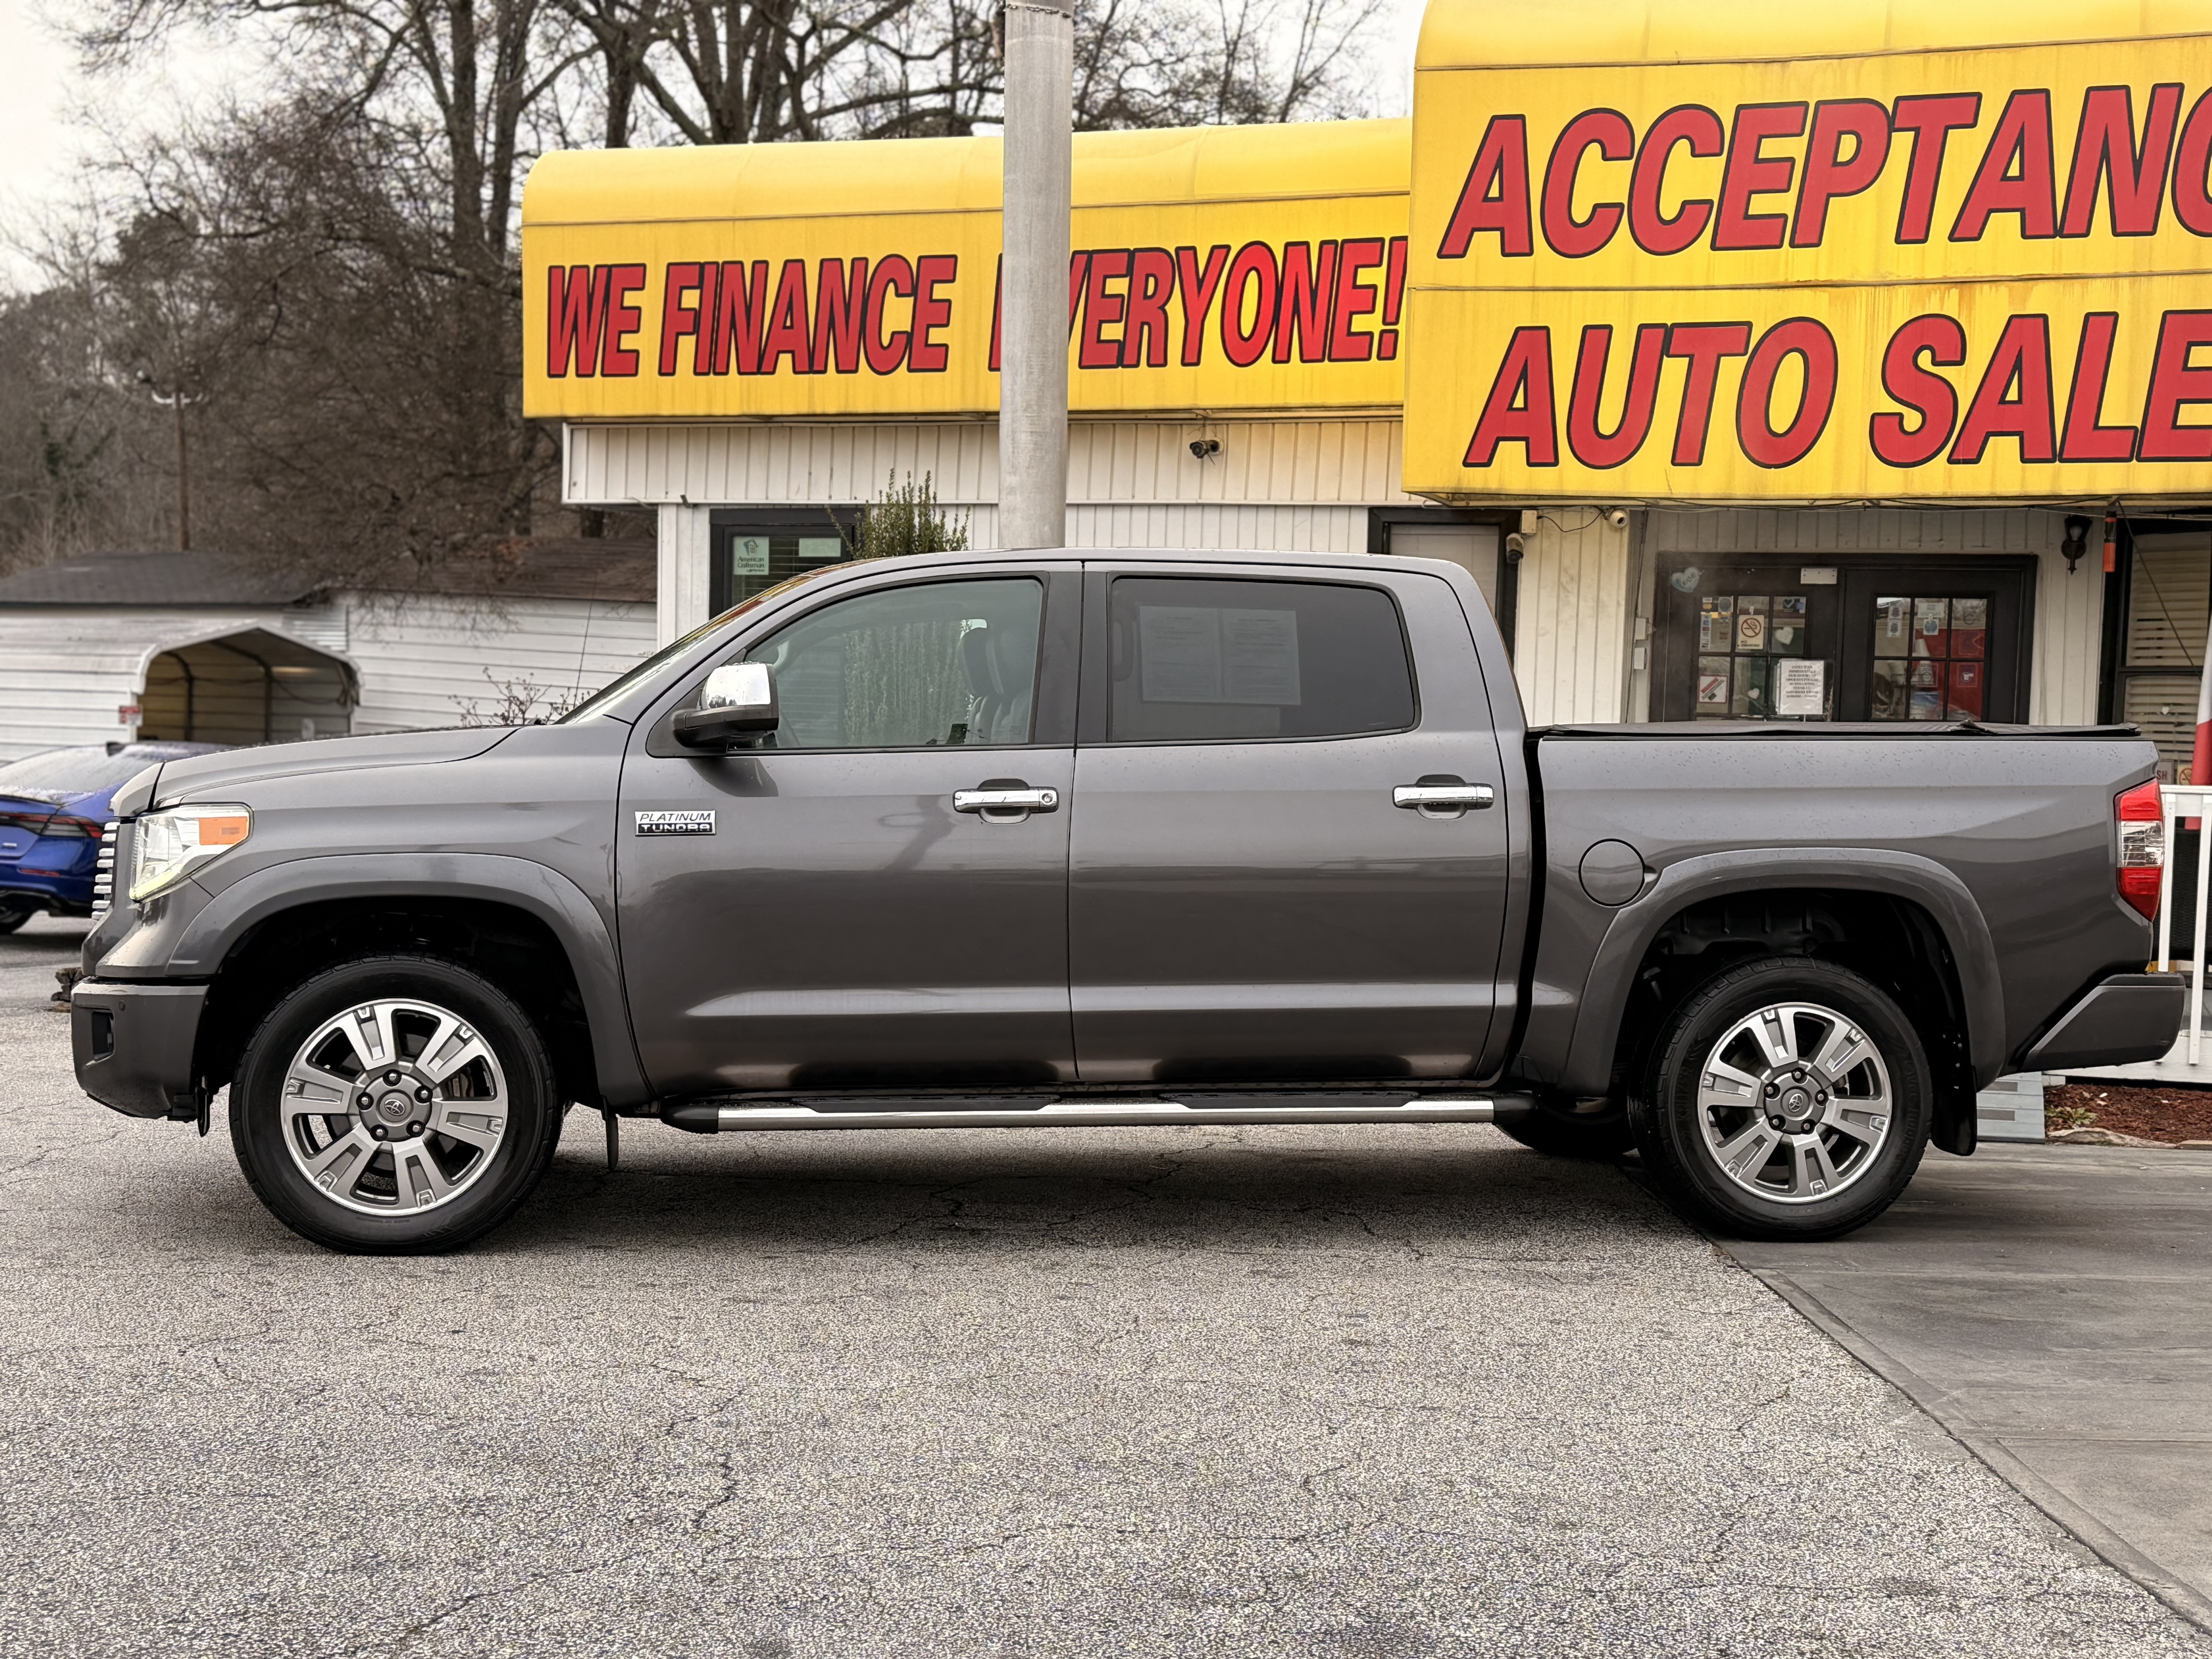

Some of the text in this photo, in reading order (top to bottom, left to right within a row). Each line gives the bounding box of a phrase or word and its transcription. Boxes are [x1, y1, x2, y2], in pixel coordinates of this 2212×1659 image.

[547, 236, 1408, 378] WE FINANCE ERYONE!
[1462, 309, 2212, 469] AUTO SALE
[640, 813, 711, 821] PLATINUM
[641, 824, 710, 832] TUNDRA
